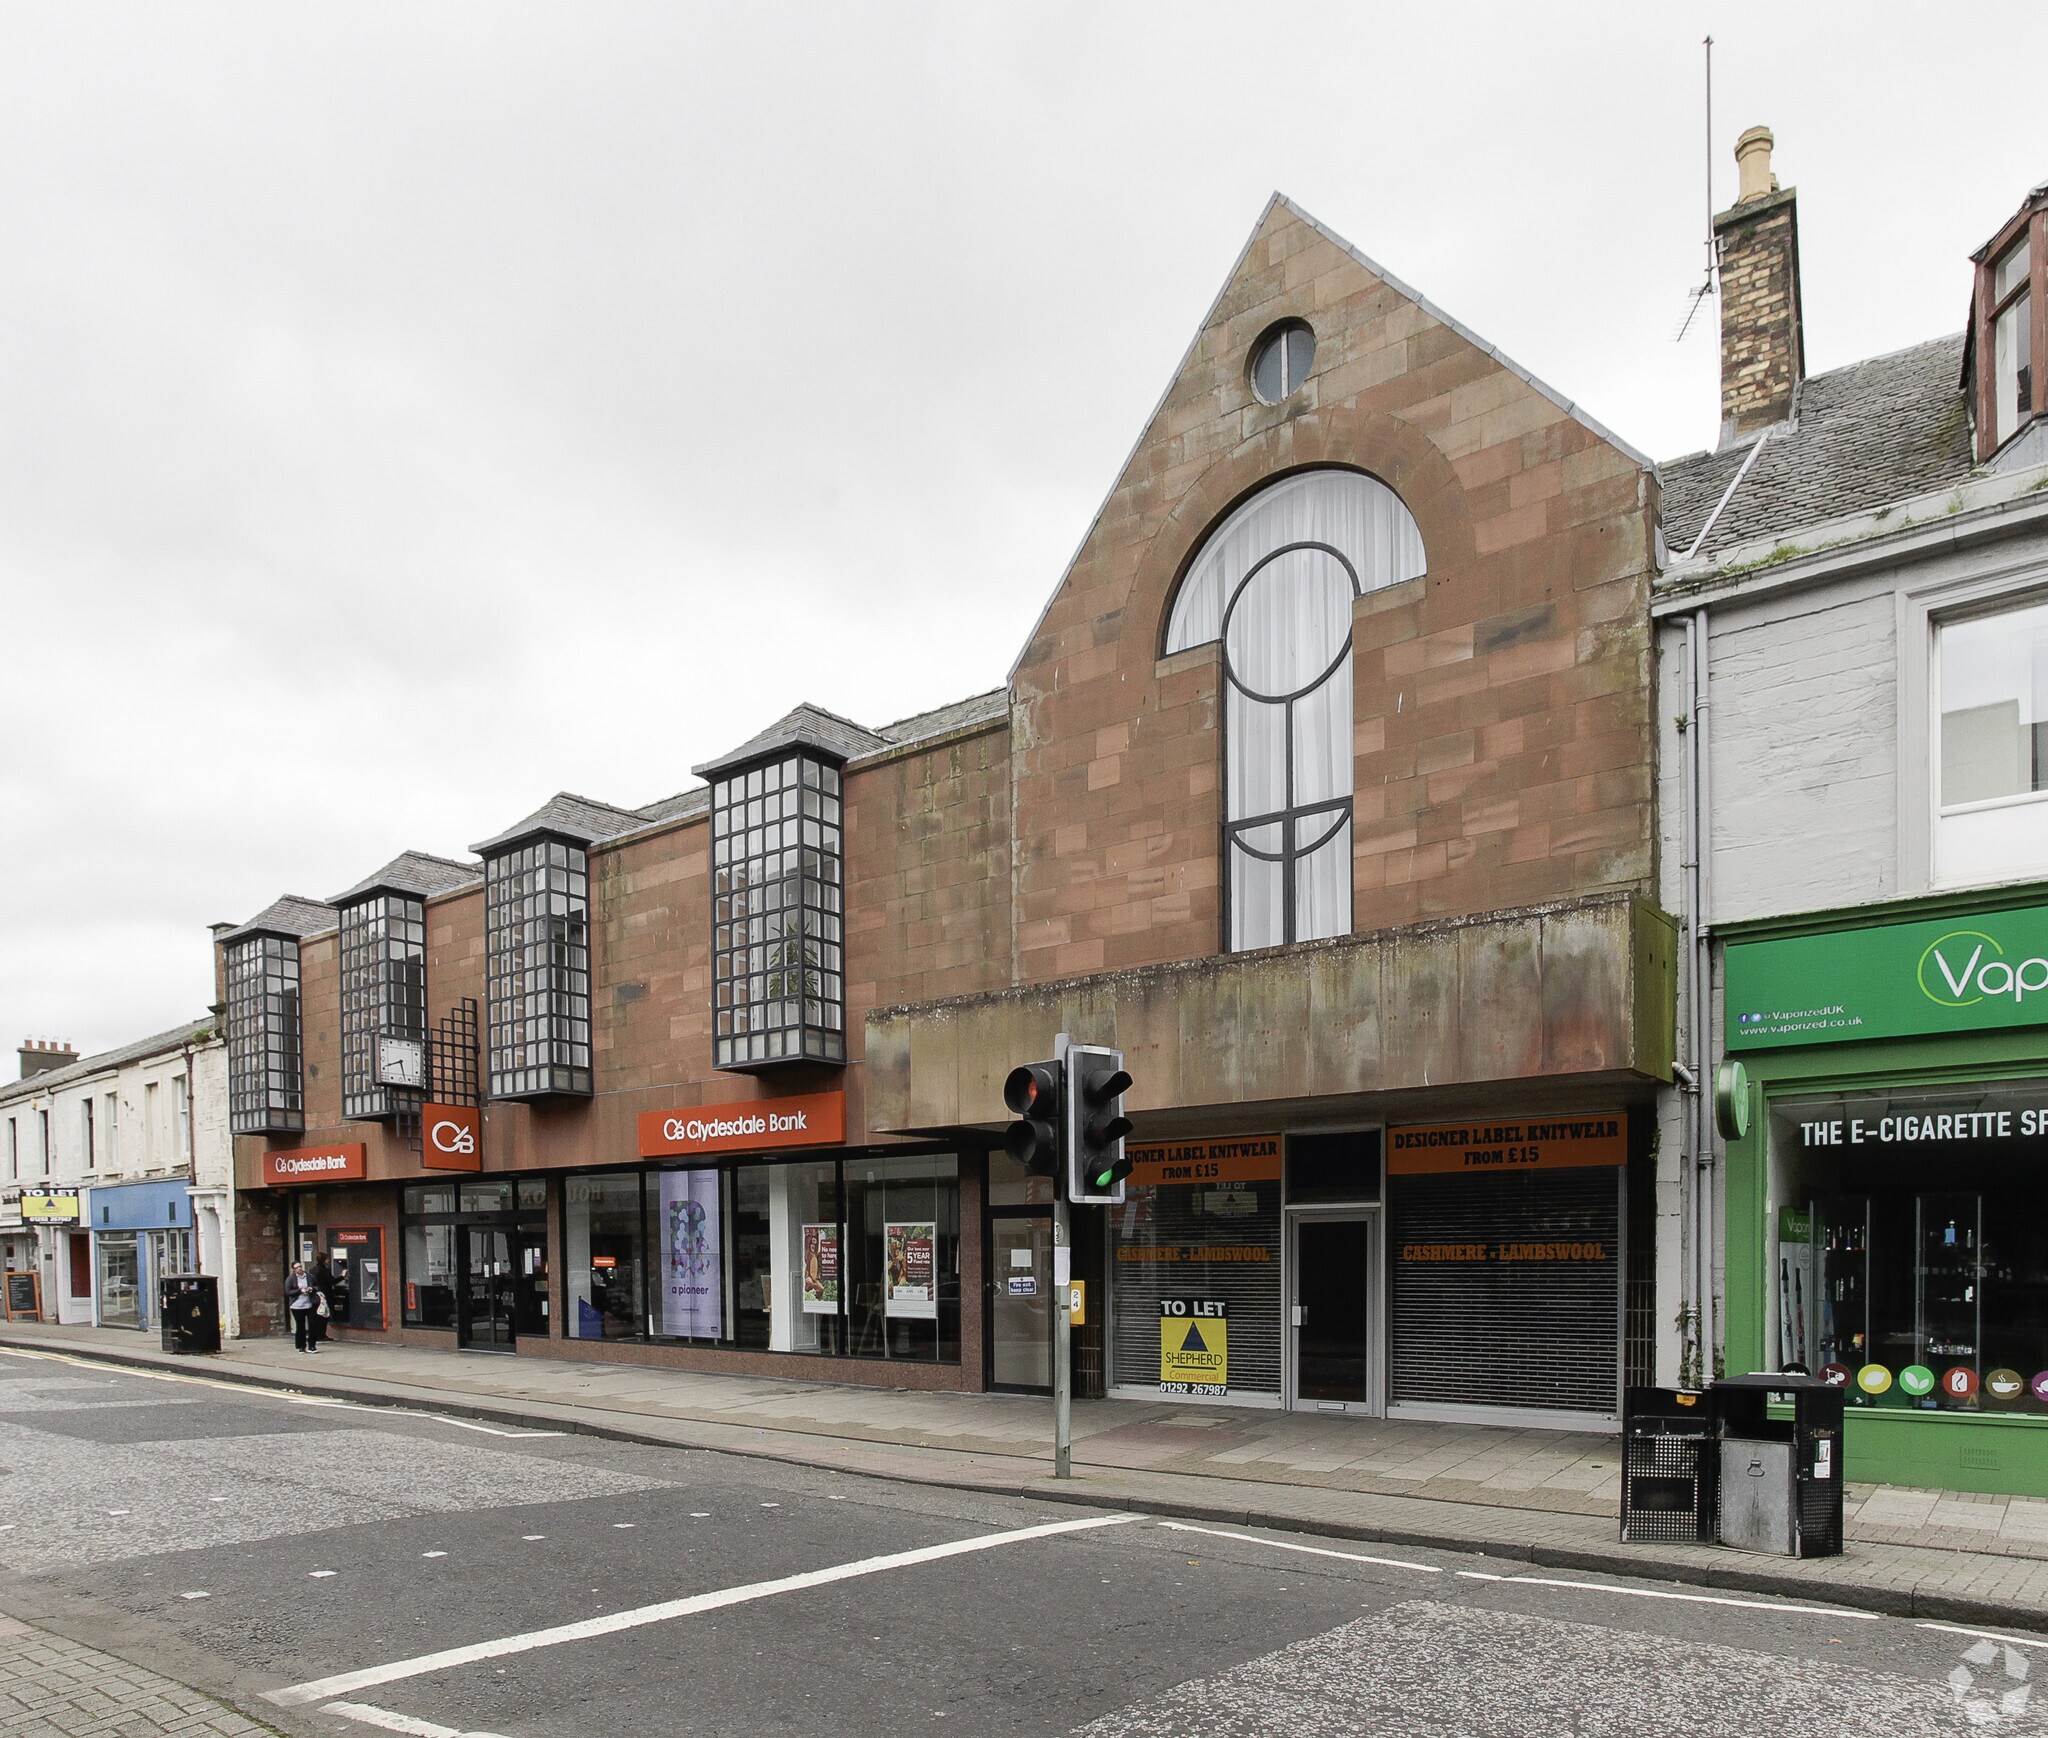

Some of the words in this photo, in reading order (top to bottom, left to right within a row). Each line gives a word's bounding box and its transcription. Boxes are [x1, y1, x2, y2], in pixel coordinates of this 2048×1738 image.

[1739, 1016, 1863, 1036] www.vaporized.co.uk
[686, 1114, 766, 1142] Clydesdale
[769, 1110, 808, 1132] Bank
[1394, 1128, 1470, 1149] DESIGNER
[1472, 1126, 1523, 1145] LABEL
[1527, 1120, 1618, 1142] KNITWEAR
[1800, 1119, 1842, 1146] THE
[1851, 1110, 2012, 1144] E-CIGARETTE
[1126, 1147, 1166, 1164] IGNER
[1167, 1144, 1207, 1162] LABEL
[1208, 1141, 1277, 1159] KNITWEAR
[1464, 1150, 1504, 1166] FROM
[1508, 1146, 1540, 1163] £15
[287, 1157, 326, 1174] Clydesdale
[326, 1155, 347, 1170] Bank
[1162, 1167, 1192, 1179] FROM
[1195, 1163, 1219, 1178] £15
[23, 1189, 44, 1197] TO
[50, 1189, 76, 1197] LET
[907, 1252, 913, 1264] 5
[913, 1252, 930, 1260] YEAR
[1116, 1246, 1181, 1263] CASHMERE
[1190, 1246, 1270, 1262] LAMBSWOOL
[1402, 1244, 1487, 1262] CASHMERE
[1499, 1242, 1606, 1261] LAMBSWOOL
[672, 1286, 677, 1294] a
[678, 1284, 709, 1296] pioneer
[1160, 1300, 1186, 1317] TO
[1194, 1301, 1226, 1317] LET
[1166, 1350, 1223, 1366] SHEPHERD
[1169, 1369, 1219, 1382] Commercial
[1160, 1382, 1188, 1394] 01292
[1191, 1383, 1228, 1396] 267987
